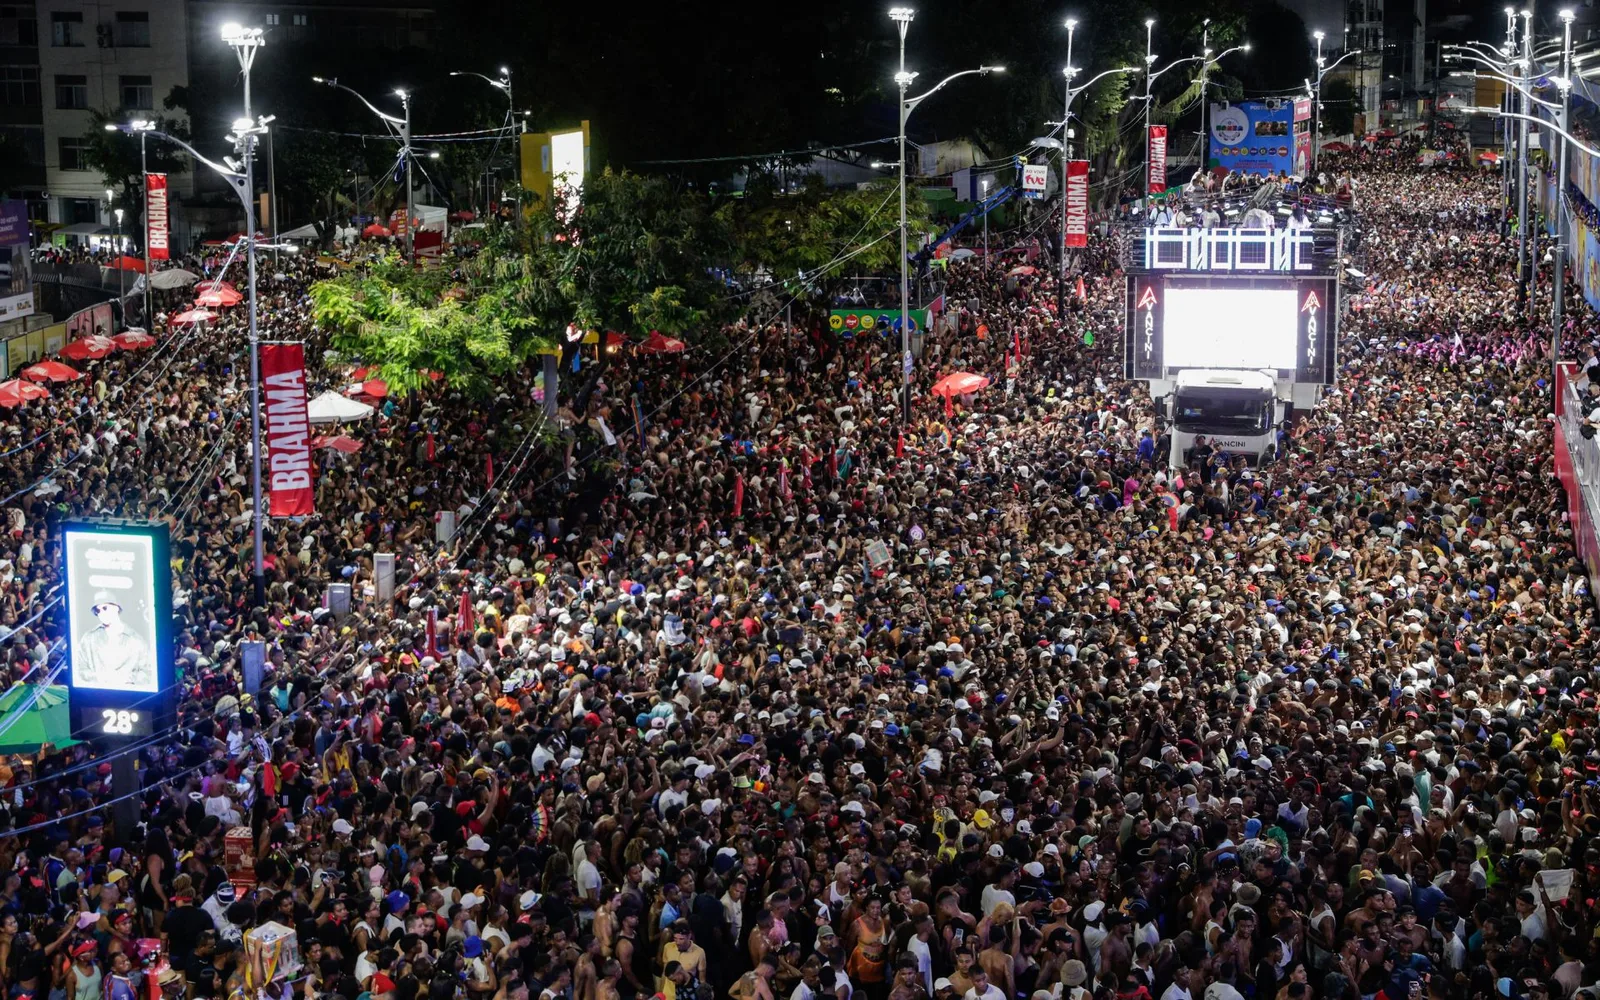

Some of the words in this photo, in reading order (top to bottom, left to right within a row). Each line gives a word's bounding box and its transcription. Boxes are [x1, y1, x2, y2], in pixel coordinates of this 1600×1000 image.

[1150, 136, 1166, 185] BRAHMA
[149, 188, 167, 249] BRAHMA
[1067, 174, 1087, 235] BRAHMA
[265, 369, 310, 491] BRAHMA
[1209, 437, 1246, 448] AANCINI
[102, 709, 138, 734] 28°
